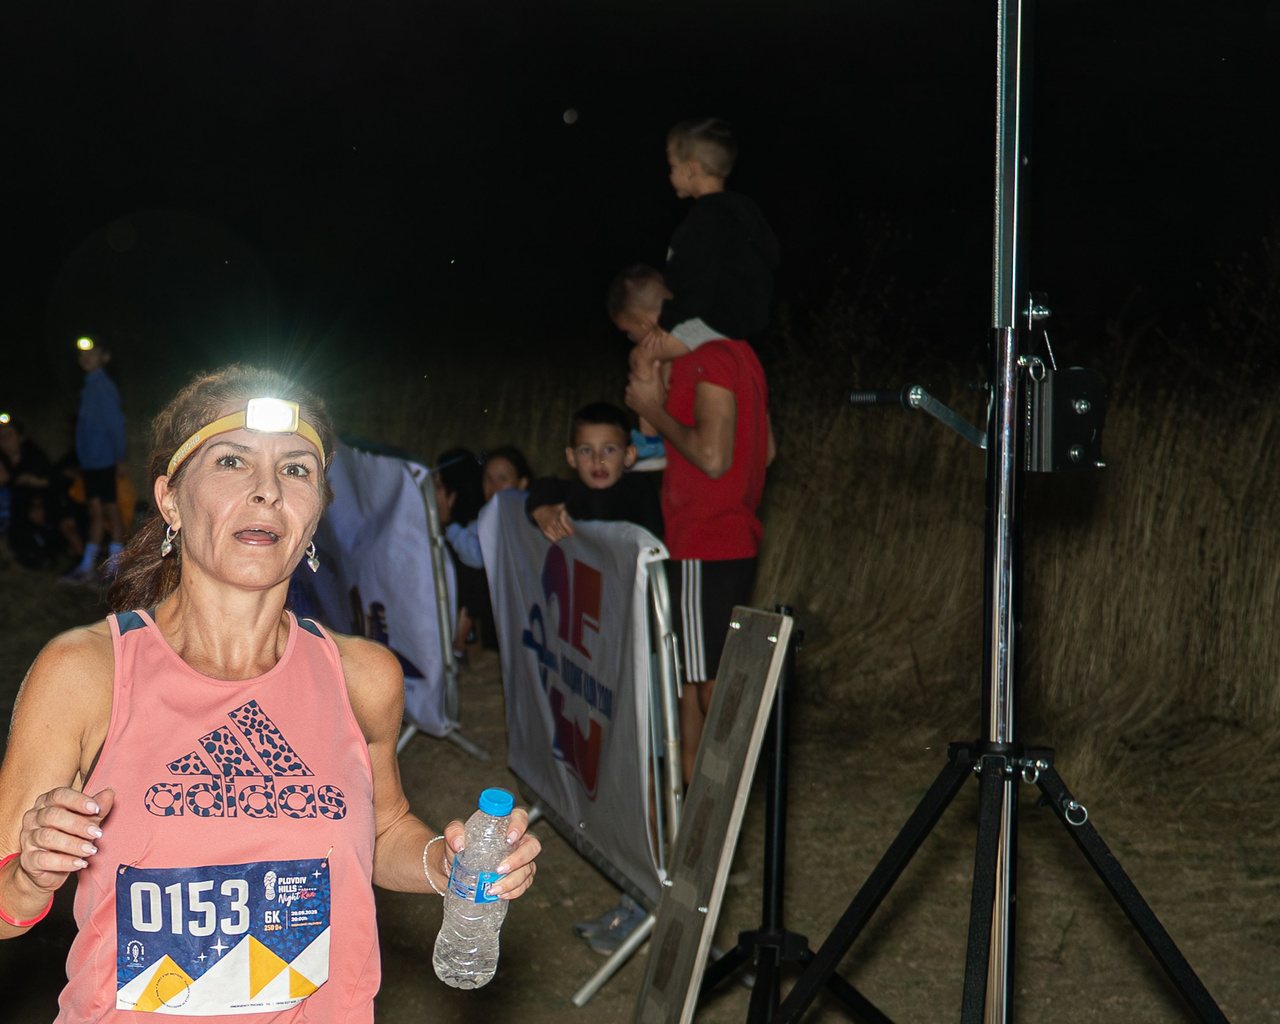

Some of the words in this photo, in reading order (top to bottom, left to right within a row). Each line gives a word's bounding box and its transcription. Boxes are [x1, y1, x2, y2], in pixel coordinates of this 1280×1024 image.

[176, 435, 200, 459] SIMOND
[143, 774, 347, 820] adidas
[278, 876, 307, 885] PLOVDIV
[278, 885, 297, 893] HILLS
[278, 891, 301, 907] Night
[129, 879, 251, 937] 0153
[264, 910, 281, 924] 6K
